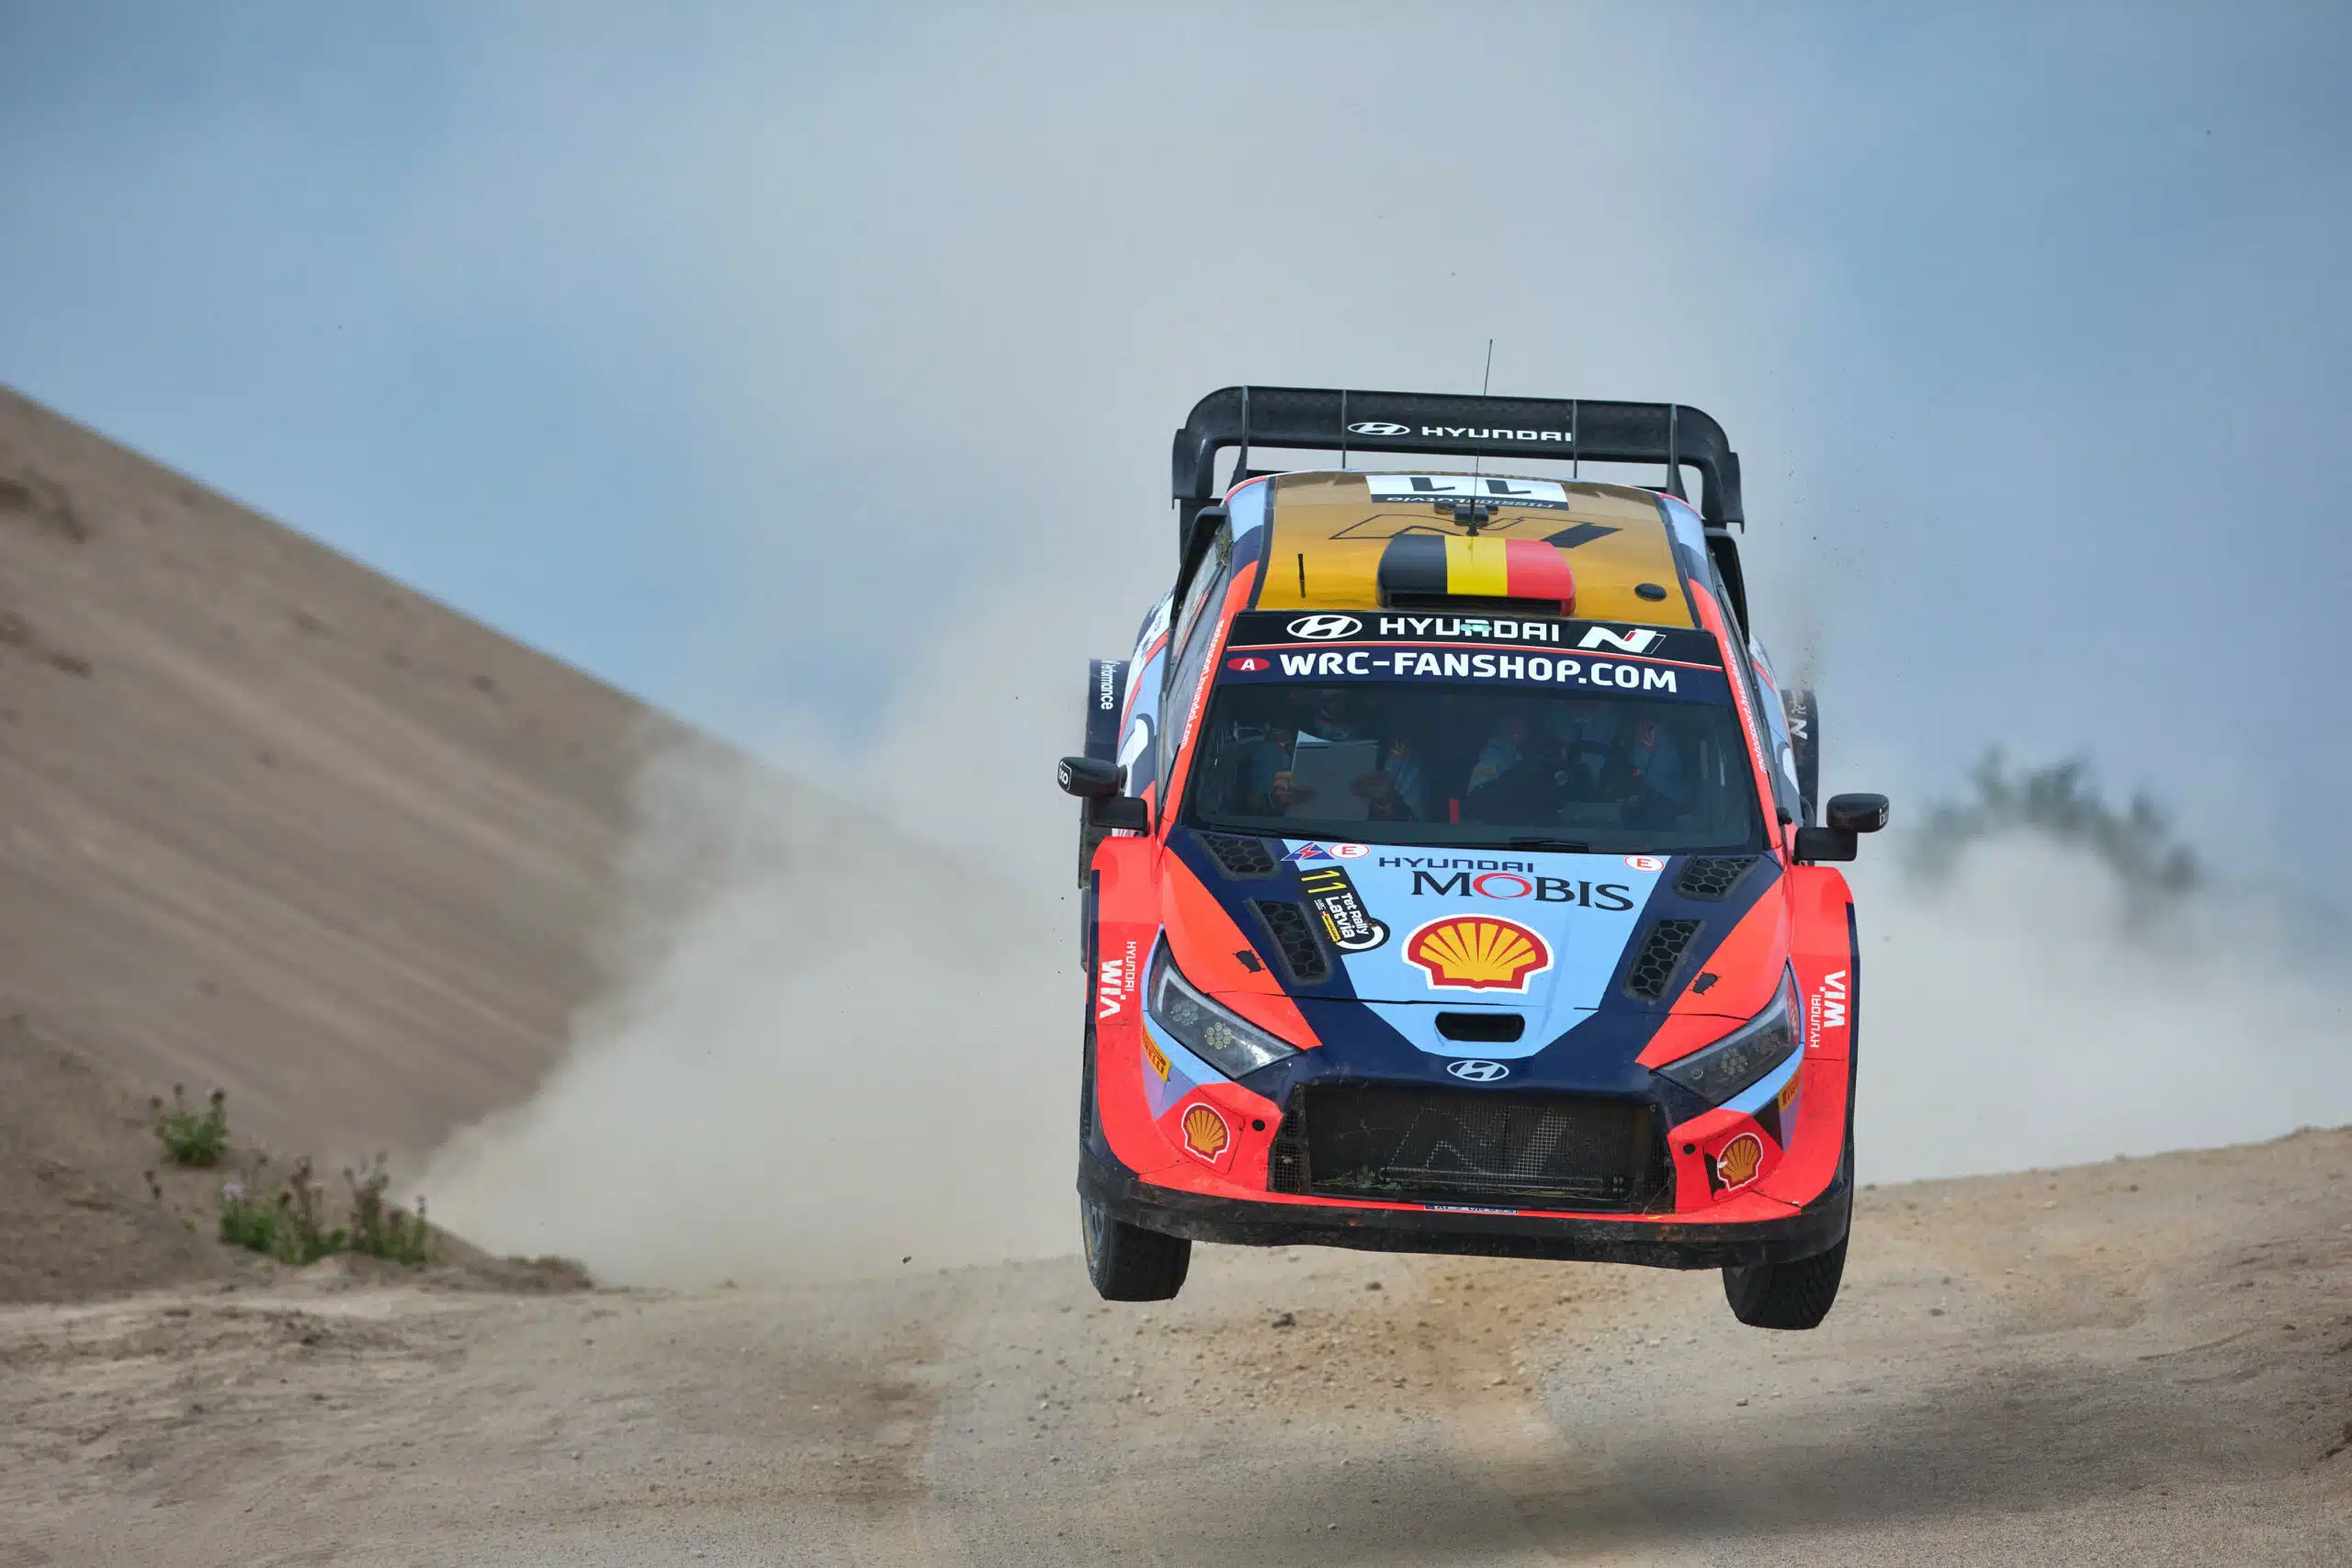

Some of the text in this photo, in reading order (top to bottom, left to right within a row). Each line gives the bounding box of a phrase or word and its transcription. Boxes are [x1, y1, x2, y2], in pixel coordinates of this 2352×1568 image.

[1421, 426, 1573, 442] HYUNDAI
[1410, 477, 1532, 495] 11
[1380, 617, 1559, 642] HYUNDAI
[1240, 659, 1256, 671] A
[1280, 651, 1678, 694] WRC-FANSHOP.COM
[1342, 846, 1357, 855] E
[1379, 857, 1533, 873] HYUNDAI
[1636, 858, 1652, 869] E
[1301, 870, 1347, 894] 11
[1411, 871, 1634, 911] MOBIS
[1325, 896, 1356, 939] Latvia
[1341, 892, 1370, 935] Tet Rally
[1125, 941, 1136, 992] HYUNDAI
[1810, 994, 1821, 1048] HYUNDAI
